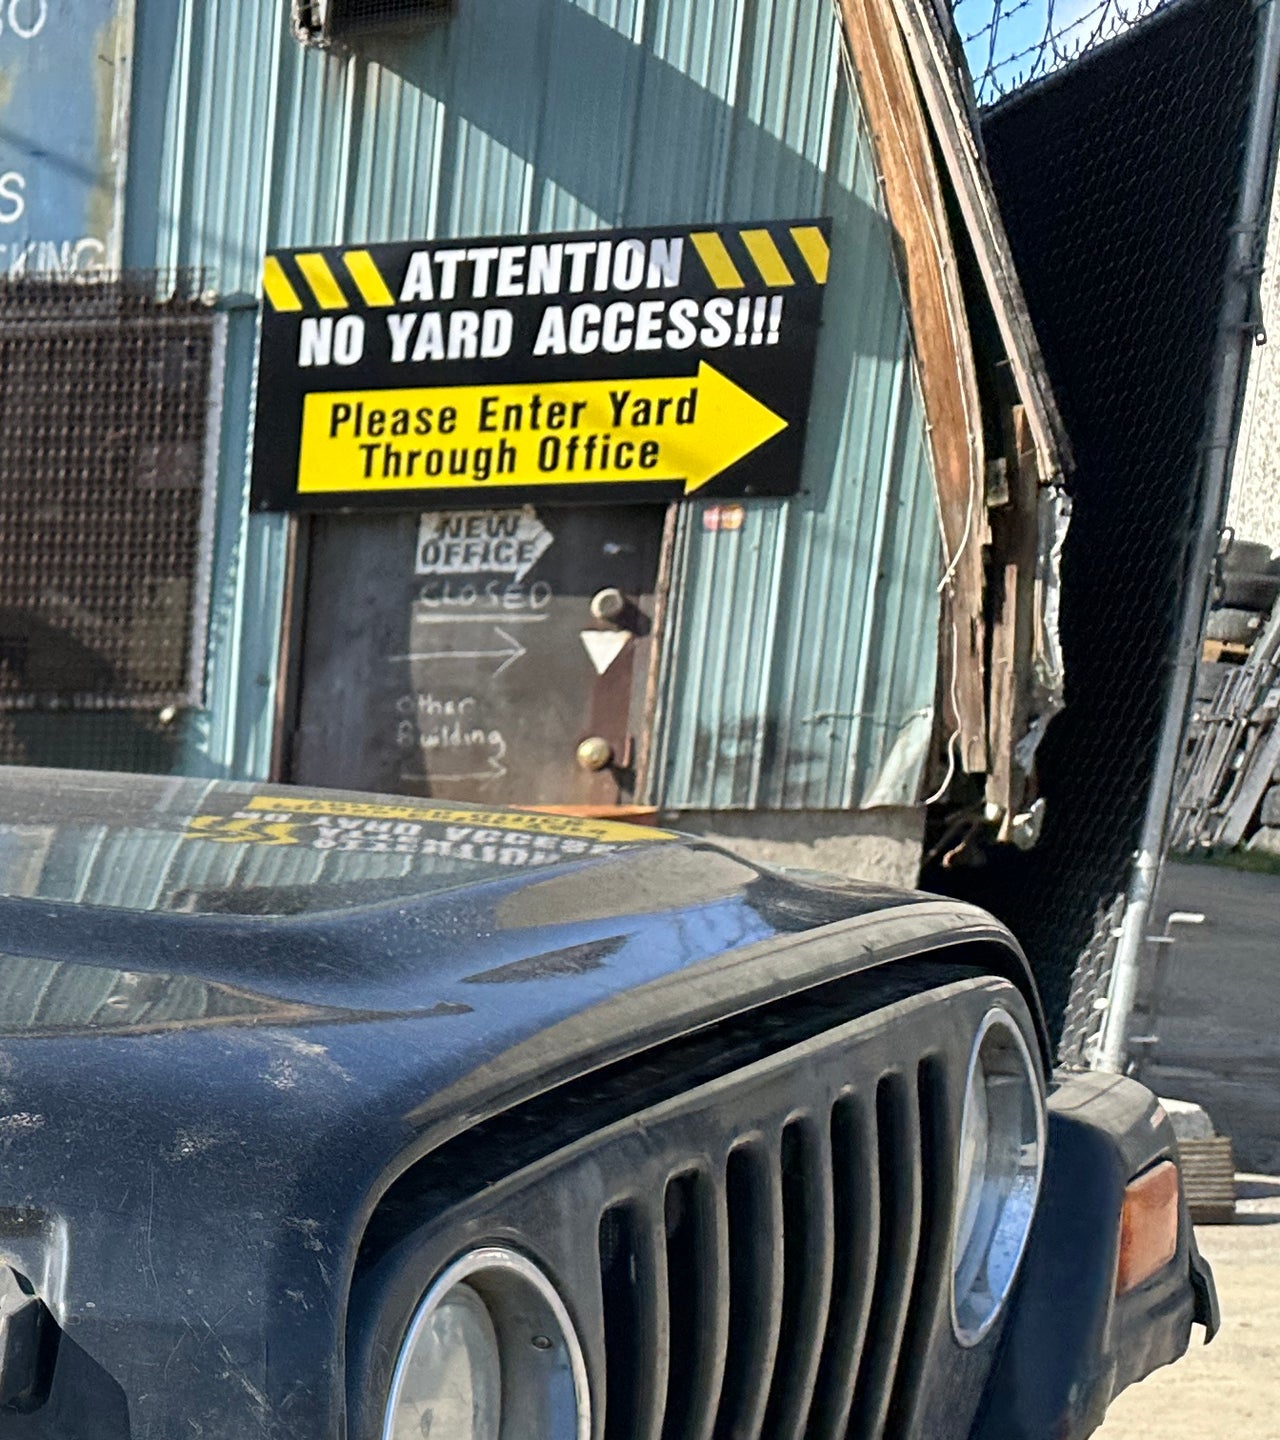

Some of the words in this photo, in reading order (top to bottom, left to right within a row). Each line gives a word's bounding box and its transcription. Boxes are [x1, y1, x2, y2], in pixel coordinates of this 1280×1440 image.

[399, 236, 684, 303] ATTENTION
[298, 315, 366, 367] NO
[386, 308, 514, 364] YARD
[533, 295, 783, 357] ACCESS!!!
[328, 400, 456, 438] Please
[478, 394, 587, 433] Enter
[609, 387, 698, 427] Yard
[359, 437, 516, 481] Through
[537, 437, 661, 474] Office
[435, 515, 521, 538] NEW
[421, 539, 536, 565] OFFICE
